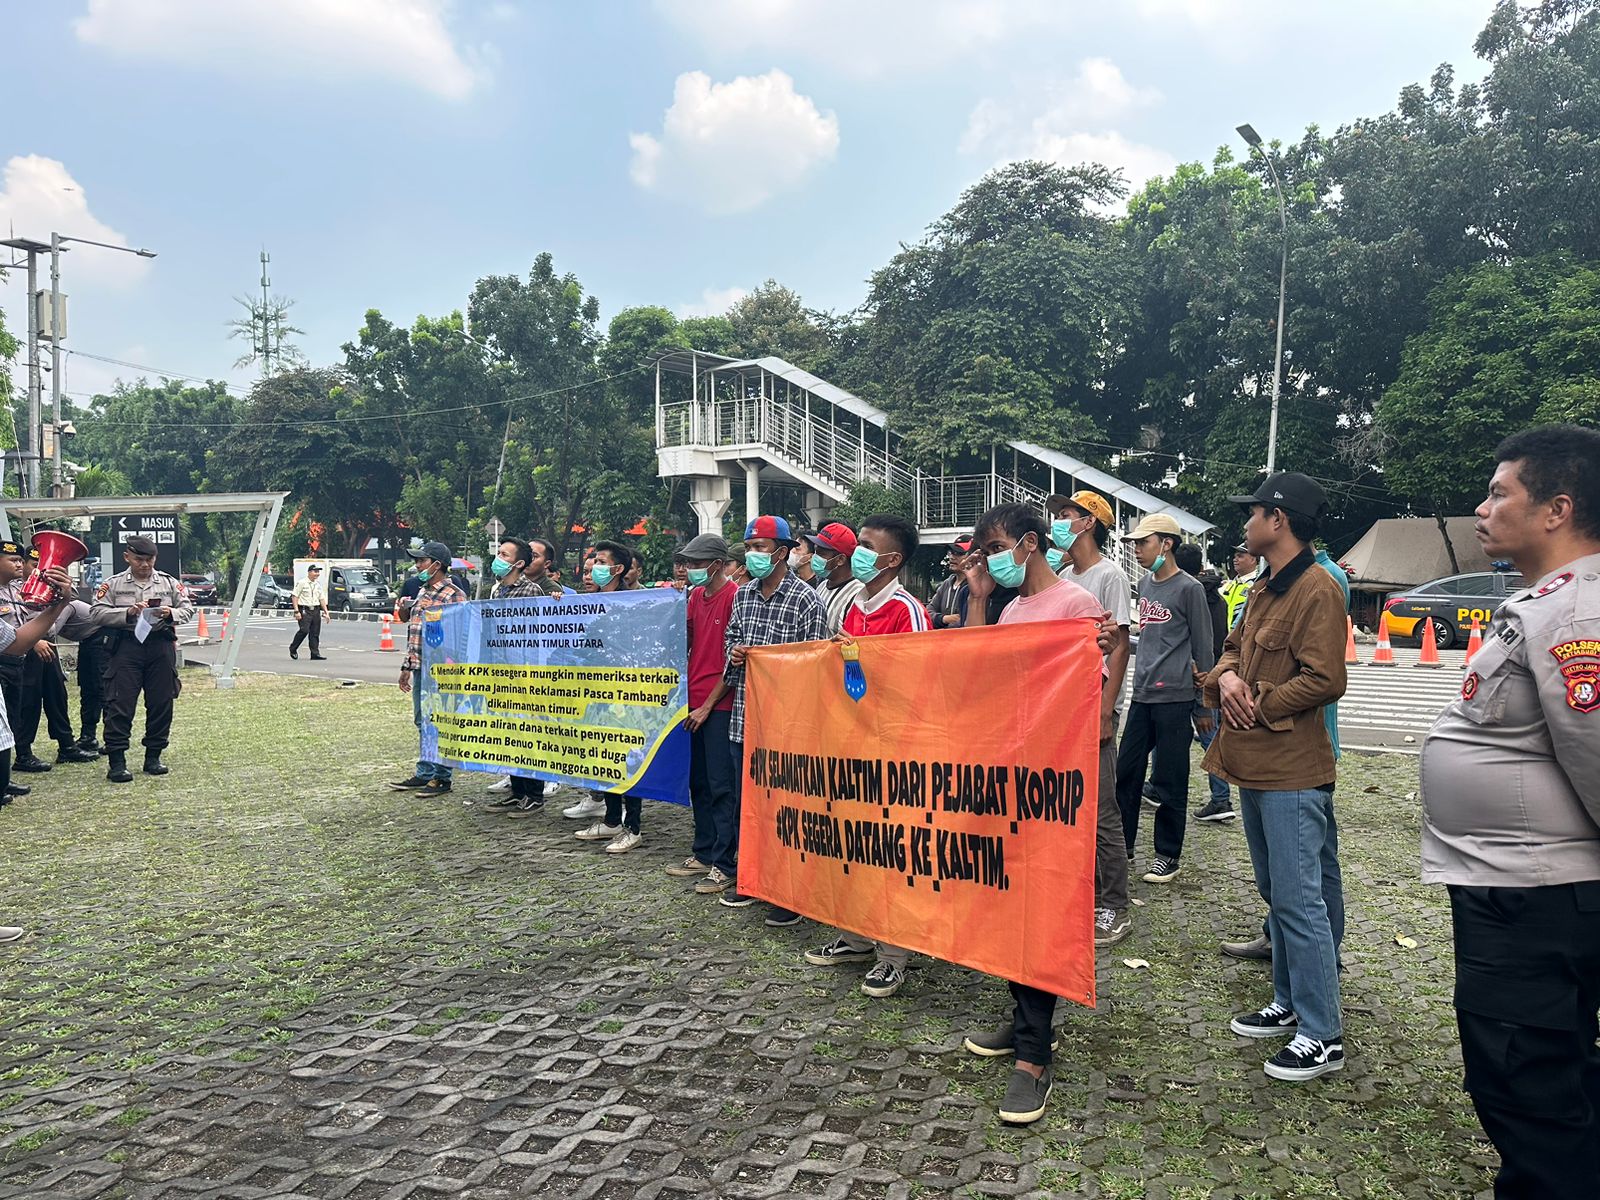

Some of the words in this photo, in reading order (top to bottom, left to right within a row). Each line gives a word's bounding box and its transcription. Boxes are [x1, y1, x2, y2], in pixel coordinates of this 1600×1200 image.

[141, 517, 175, 529] MASUK
[481, 606, 540, 618] PERGERAKAN
[542, 603, 607, 616] MAHASISWA
[496, 624, 526, 635] ISLAM
[529, 623, 586, 634] INDONESIA
[487, 639, 540, 648] KALIMANTAN
[542, 639, 571, 648] TIMUR
[572, 638, 604, 648] UTARA
[430, 667, 436, 676] 1.
[468, 667, 490, 676] KPK
[491, 669, 528, 680] sesegera
[530, 669, 574, 681] mungkin
[577, 670, 637, 683] memeriksa
[640, 672, 679, 684] terkait
[1564, 663, 1584, 673] METRO
[464, 682, 491, 692] dana
[492, 683, 527, 694] Jaminan
[529, 685, 581, 698] Reklamasi
[583, 688, 613, 700] Pasca
[616, 690, 668, 706] Tambang
[487, 699, 546, 713] dikalimantan
[548, 703, 580, 715] timur.
[490, 719, 517, 730] aliran
[519, 721, 543, 734] dana
[545, 726, 578, 738] terkait
[581, 730, 645, 746] penyertaan
[504, 736, 534, 749] Benuo
[536, 740, 560, 753] Taka
[561, 744, 586, 759] yang
[588, 747, 599, 758] di
[601, 748, 627, 764] duga
[457, 748, 470, 758] ke
[473, 749, 548, 769] oknum-oknum
[550, 760, 590, 776] anggota
[592, 764, 626, 781] DPRD.
[768, 749, 826, 798] SELAMATKAN
[827, 756, 883, 806] KALTIM
[887, 760, 926, 808] DARI
[931, 761, 1008, 816] PEJABAT
[1014, 764, 1084, 826] KORUP
[776, 804, 801, 850] #KPK
[801, 809, 844, 860] SEGERA
[844, 818, 907, 873] DATANG
[910, 825, 933, 876] KE
[936, 828, 1009, 891] KALTIM.
